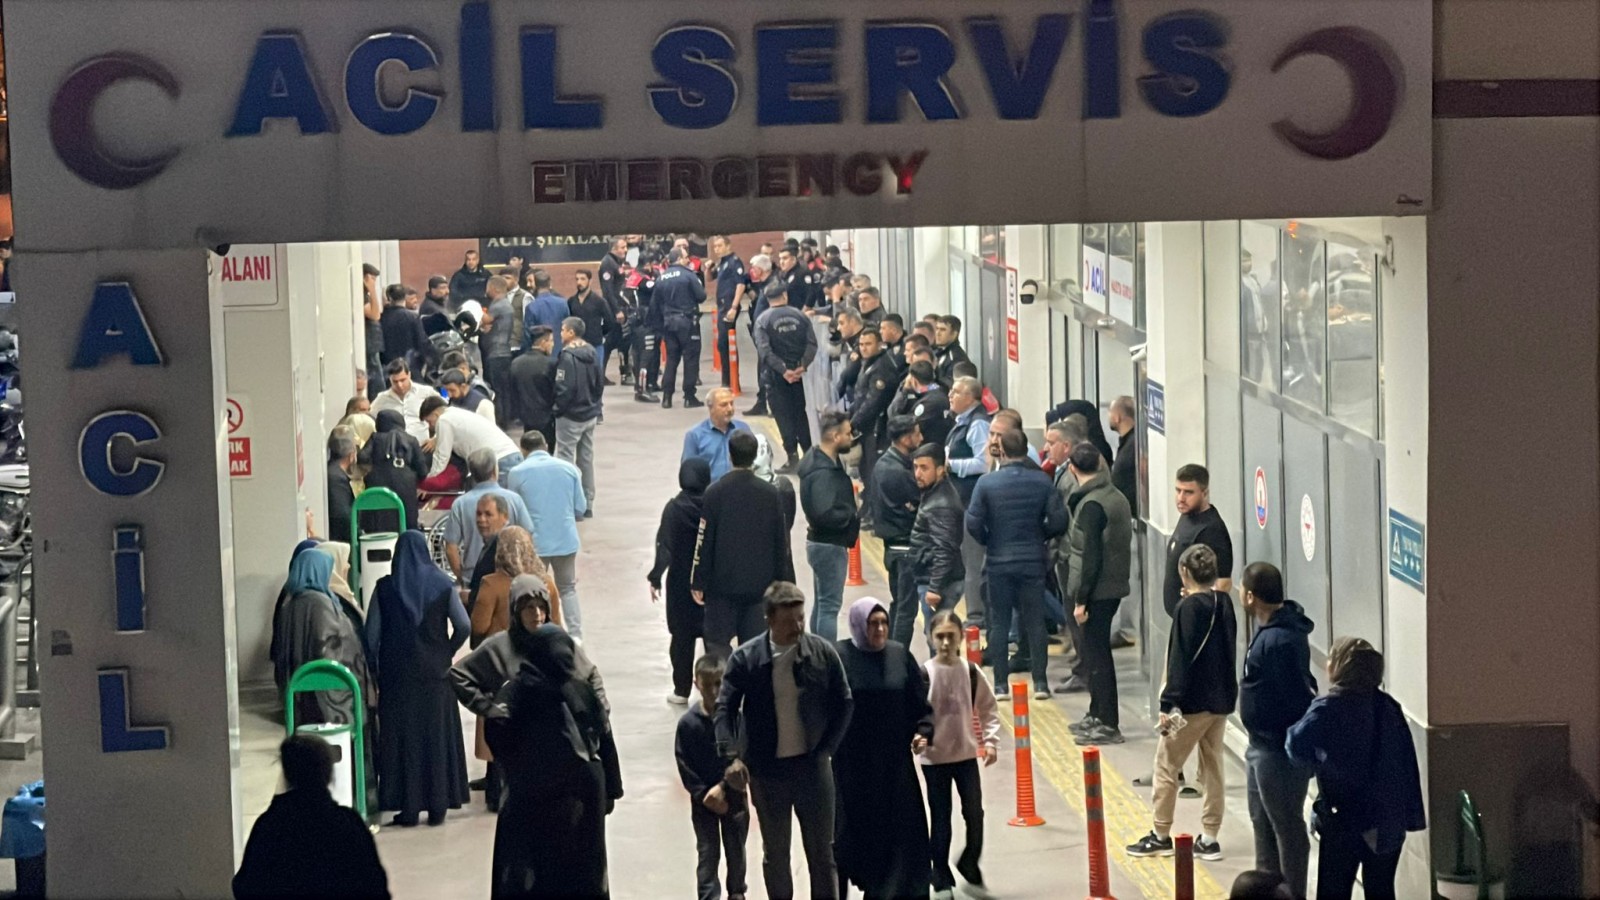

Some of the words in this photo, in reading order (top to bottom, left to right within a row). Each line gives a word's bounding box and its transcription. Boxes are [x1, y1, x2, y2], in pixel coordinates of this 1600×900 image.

[224, 1, 604, 136] ACİL
[646, 0, 1233, 129] SERVİS
[532, 150, 926, 204] EMERGENCY
[222, 256, 271, 281] ALANI
